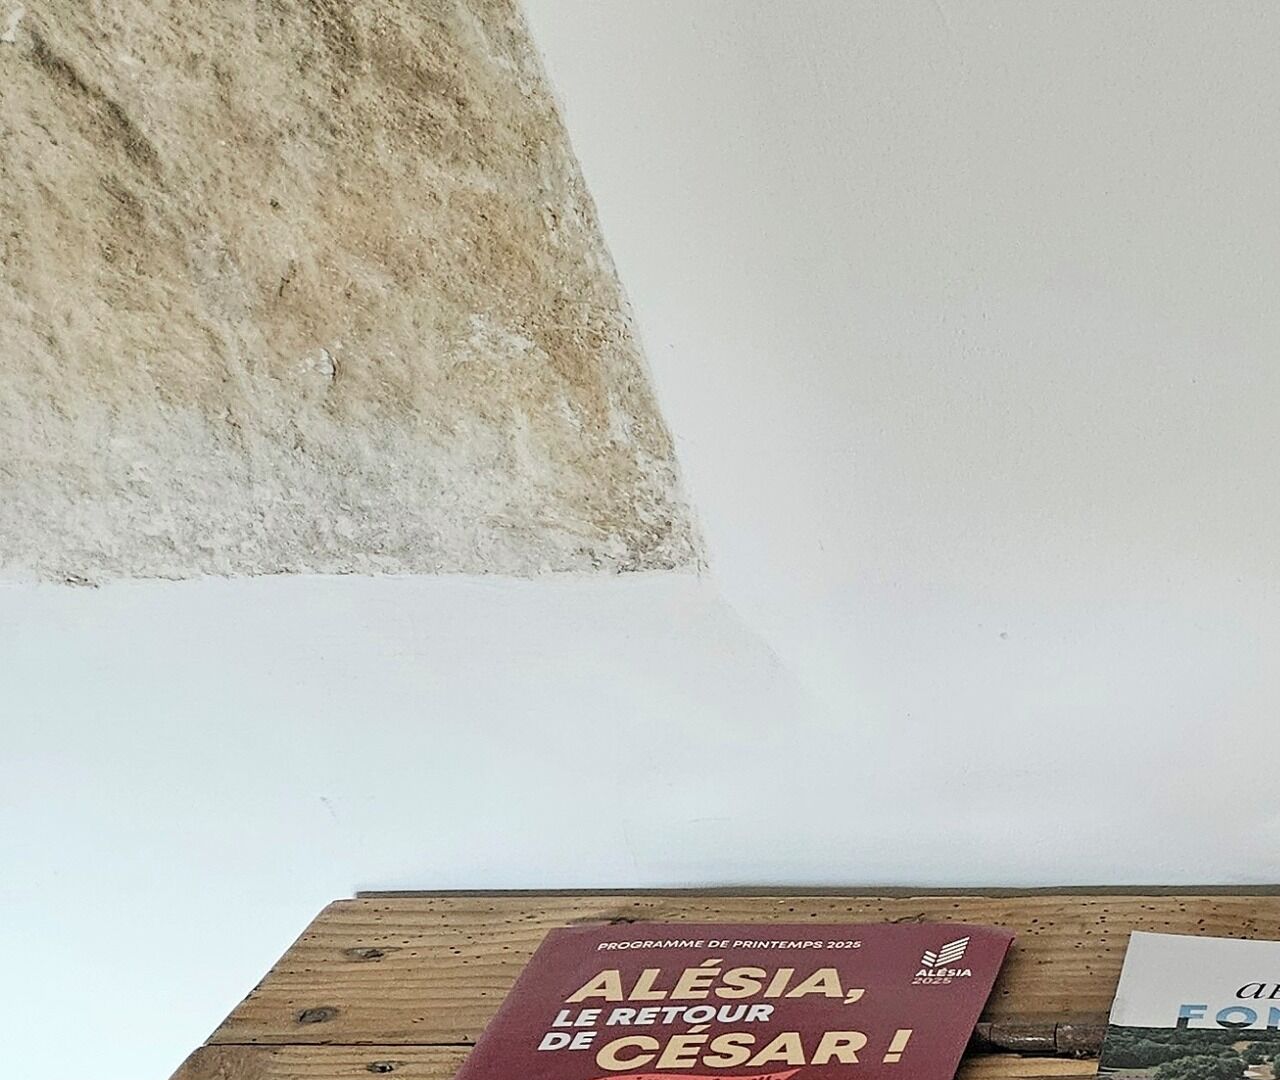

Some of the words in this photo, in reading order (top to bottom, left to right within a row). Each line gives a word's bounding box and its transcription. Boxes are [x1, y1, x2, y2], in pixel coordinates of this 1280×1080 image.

[598, 940, 704, 951] PROGRAMME
[707, 940, 729, 949] DE
[732, 940, 823, 950] PRINTEMPS
[826, 940, 862, 949] 2025
[565, 958, 866, 1004] ALÉSIA,
[915, 966, 972, 977] ALÉSIA
[552, 1008, 601, 1028] LE
[606, 1004, 775, 1027] RETOUR
[537, 1031, 597, 1051] DE
[596, 1024, 868, 1071] CÉSAR
[882, 1029, 914, 1064] !
